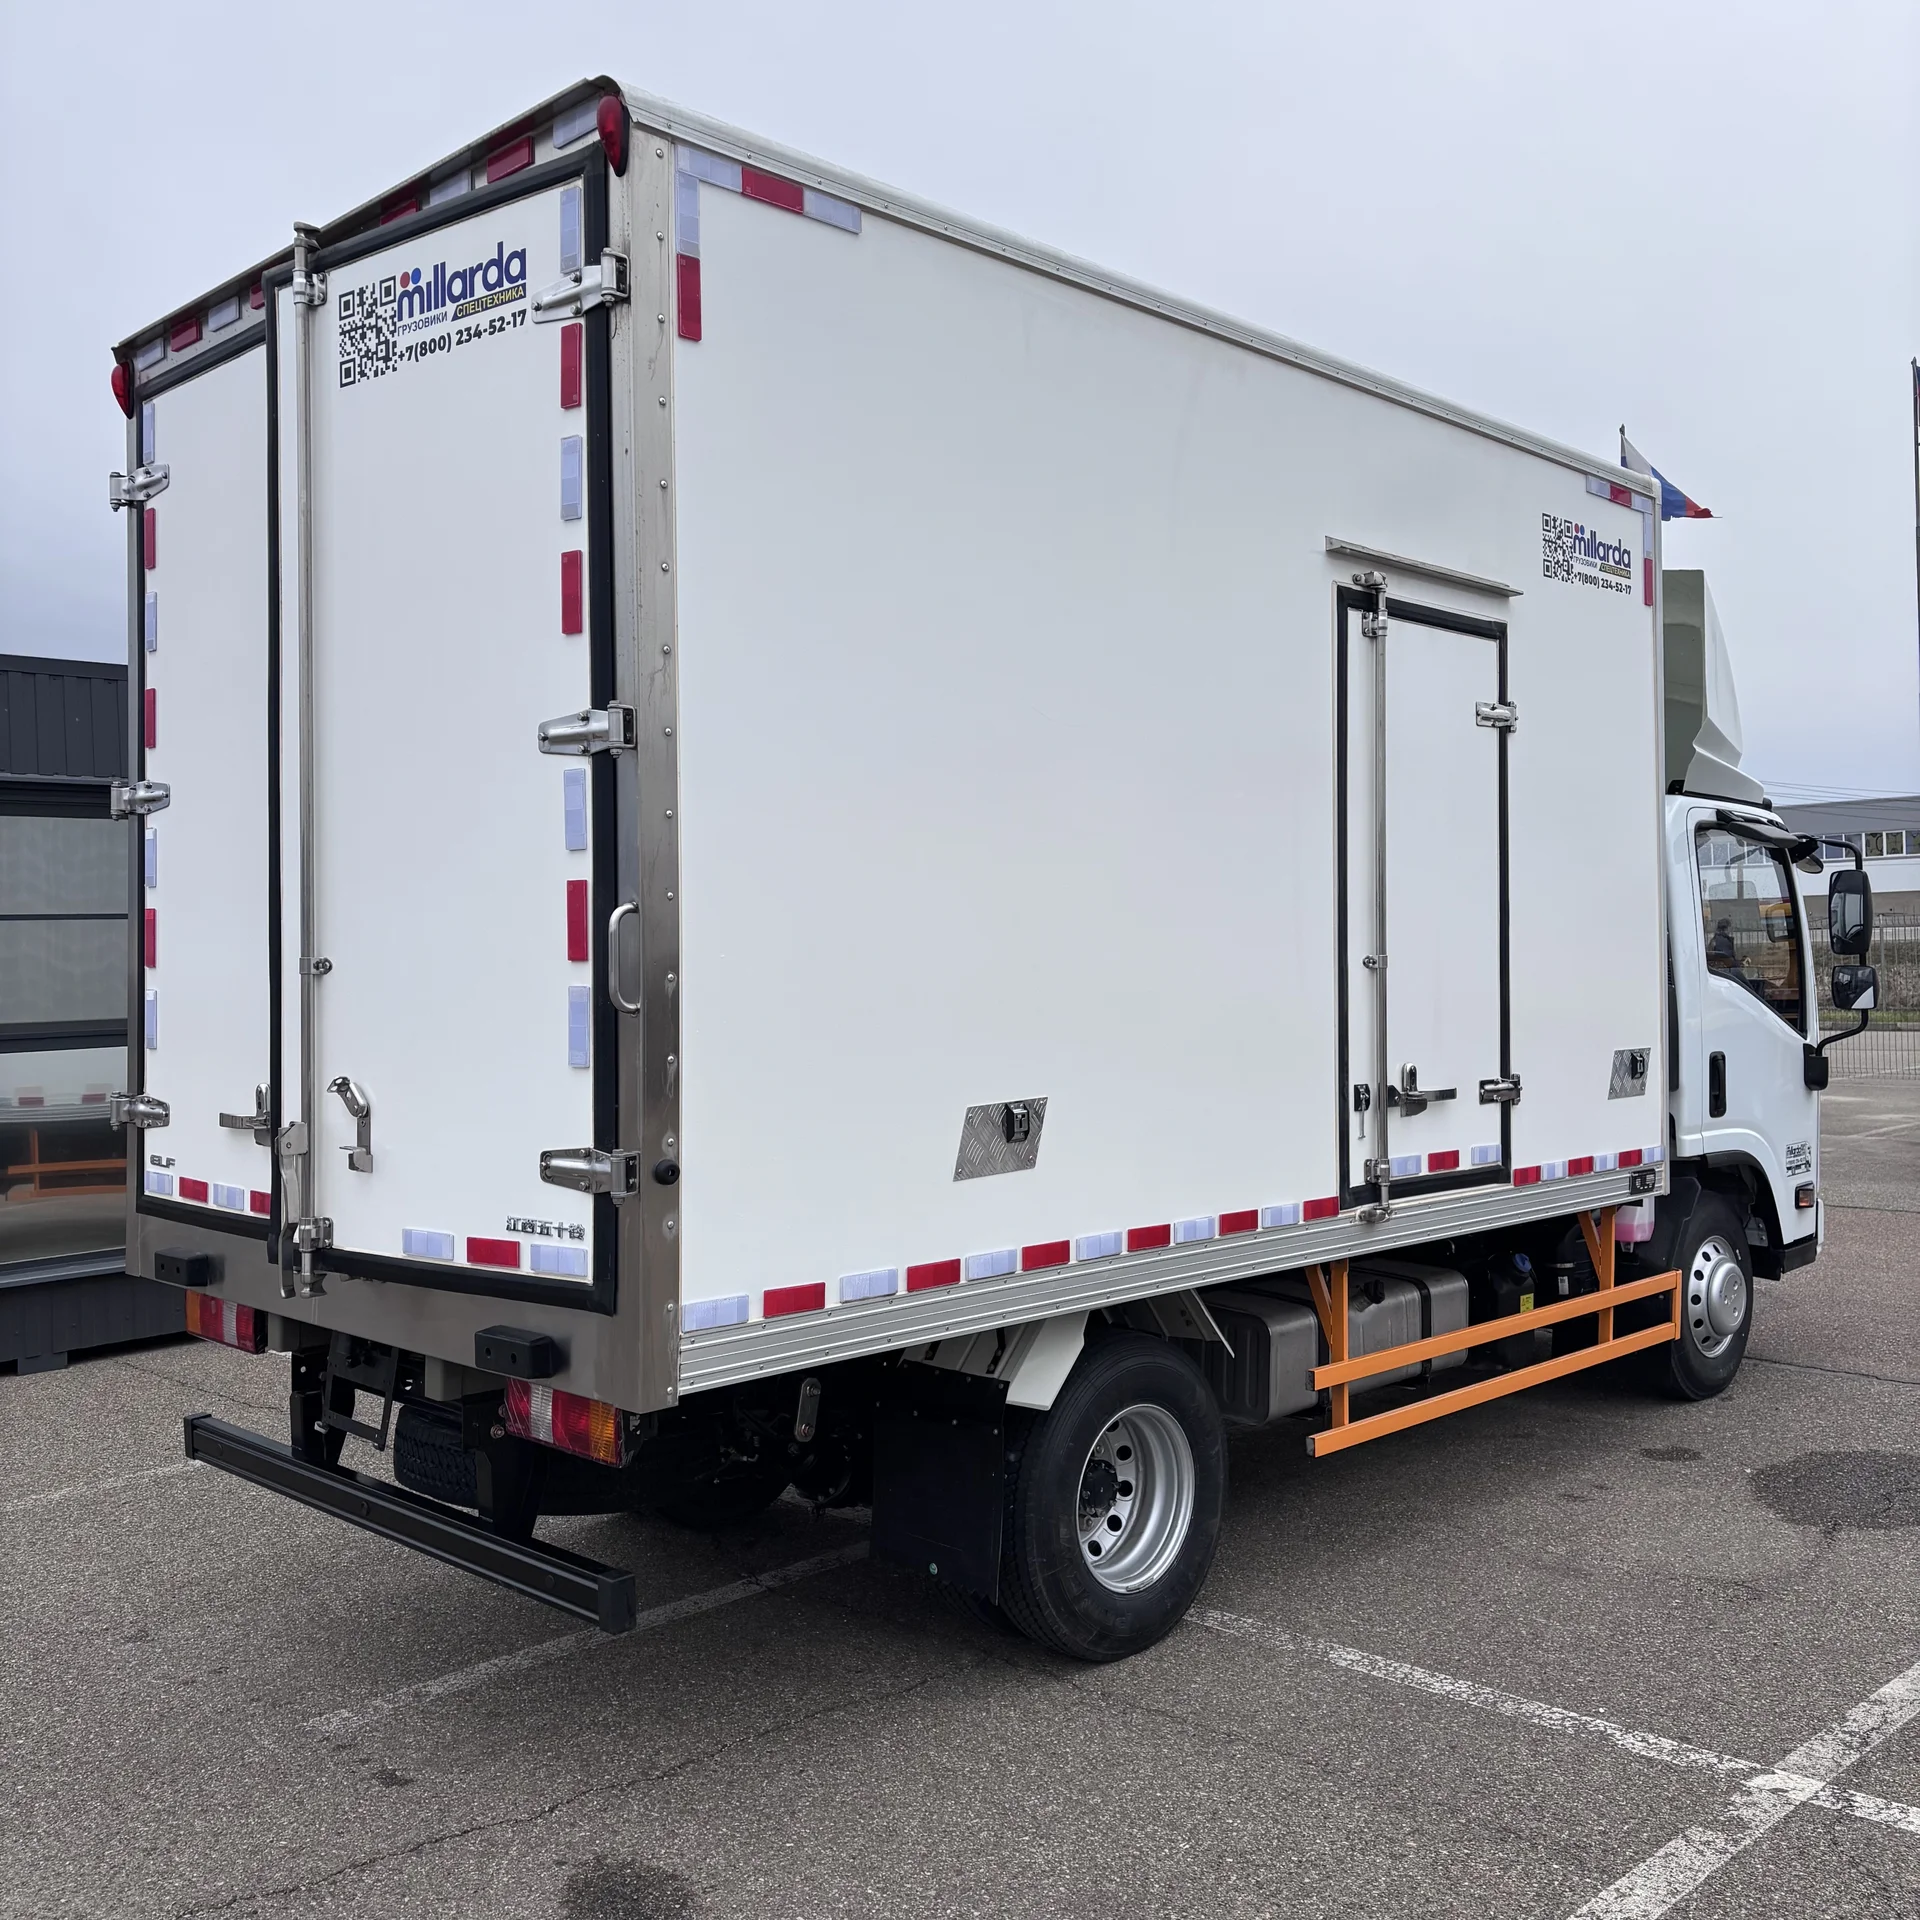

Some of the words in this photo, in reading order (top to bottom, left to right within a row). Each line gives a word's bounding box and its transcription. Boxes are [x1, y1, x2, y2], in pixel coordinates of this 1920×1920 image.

[397, 241, 527, 322] millarda
[455, 286, 525, 318] СПЕЦТЕХНИКА
[397, 310, 448, 337] ГРУЗОВИКИ
[397, 332, 452, 363] +7(800)
[455, 308, 527, 346] 234-52-17
[1573, 523, 1631, 569] millarda
[1573, 571, 1600, 589] +7(800)
[1600, 578, 1632, 595] 234-52-17
[149, 1154, 176, 1169] ELF
